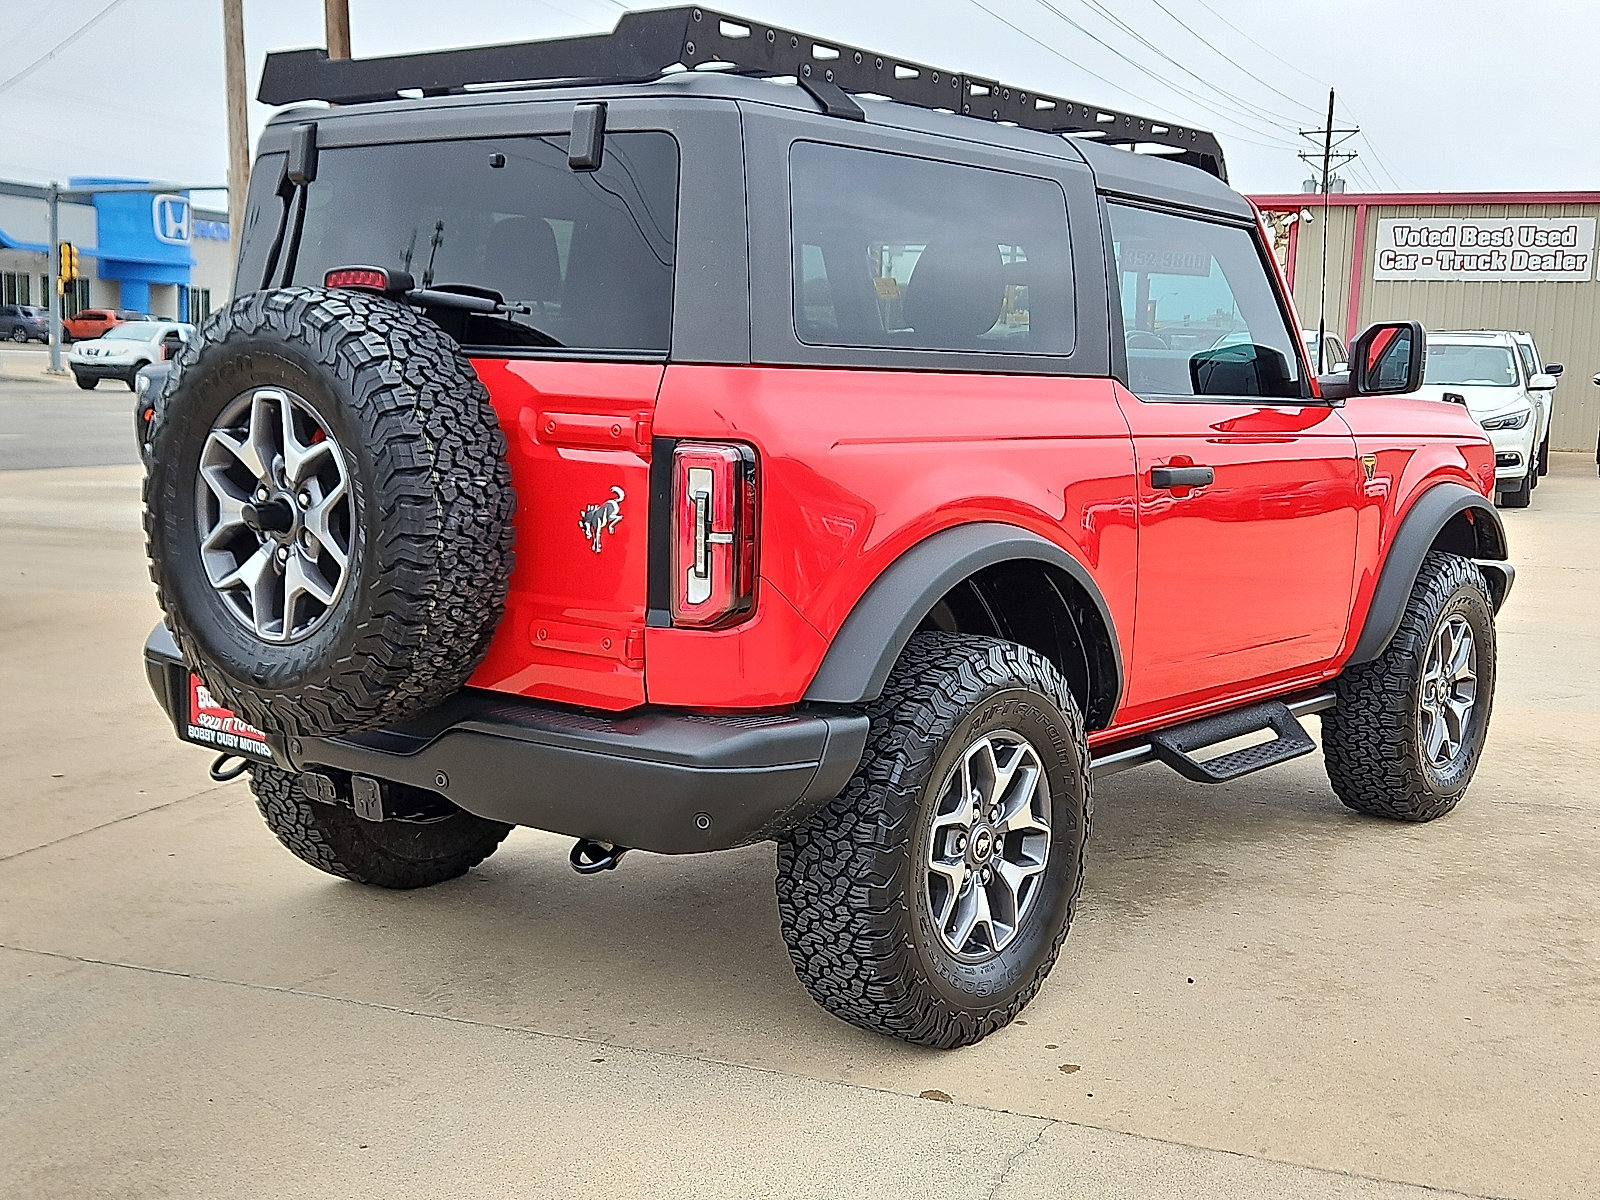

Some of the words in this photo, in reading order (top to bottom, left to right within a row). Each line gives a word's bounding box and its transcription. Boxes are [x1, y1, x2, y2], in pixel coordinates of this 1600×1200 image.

[1393, 226, 1456, 247] Voted
[1460, 226, 1513, 247] Best
[1519, 226, 1578, 247] Used
[1380, 250, 1418, 270] Car
[1437, 250, 1506, 271] Truck
[1510, 250, 1588, 271] Dealer
[197, 713, 221, 731] SOLD
[240, 737, 272, 757] MOTORS
